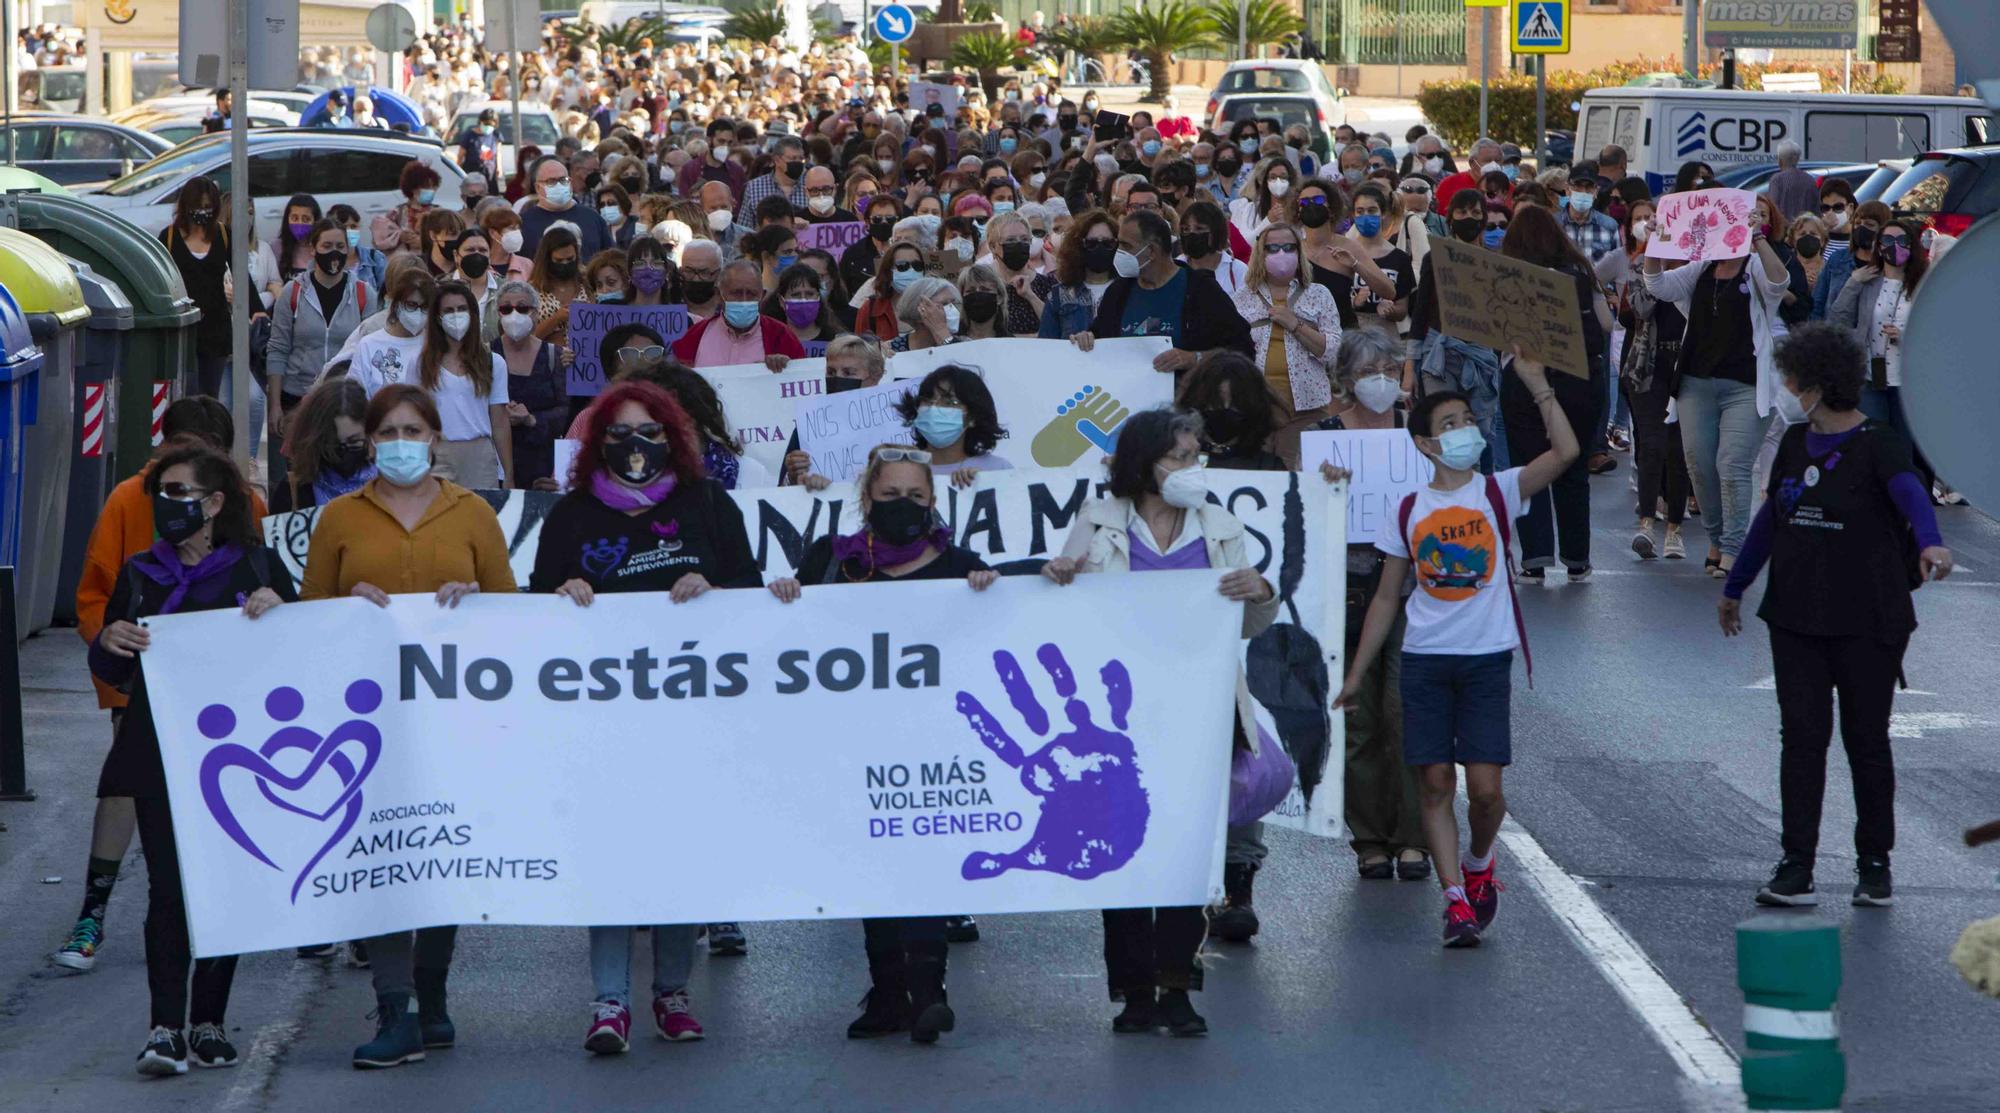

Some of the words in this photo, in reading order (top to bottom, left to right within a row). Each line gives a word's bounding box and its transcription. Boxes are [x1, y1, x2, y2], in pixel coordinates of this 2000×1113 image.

[1709, 1, 1854, 26] masymas
[1841, 35, 1852, 48] P
[1710, 117, 1787, 153] CBP
[1701, 152, 1778, 162] CONSTRUCCION
[816, 223, 867, 249] EDUCA
[572, 308, 622, 332] SOMOS
[646, 310, 683, 335] GRITO
[572, 337, 589, 359] DE
[572, 361, 598, 383] NO
[805, 404, 839, 442] NOS
[1332, 438, 1365, 485] NI
[1388, 438, 1434, 484] UN
[1440, 518, 1483, 542] SKATE
[616, 556, 700, 577] SUPERVIVIENTES
[627, 550, 671, 566] AMIGAS
[399, 643, 513, 702] No
[538, 640, 749, 702] estás
[775, 632, 941, 695] sola
[865, 763, 911, 789] NO
[920, 754, 987, 787] MÁS
[868, 787, 994, 811] VIOLENCIA
[369, 801, 456, 824] ASOCIACIÓN
[869, 816, 904, 839] DE
[912, 809, 1023, 837] GÉNERO
[346, 824, 473, 860] AMIGAS
[312, 856, 559, 898] SUPERVIVIENTES
